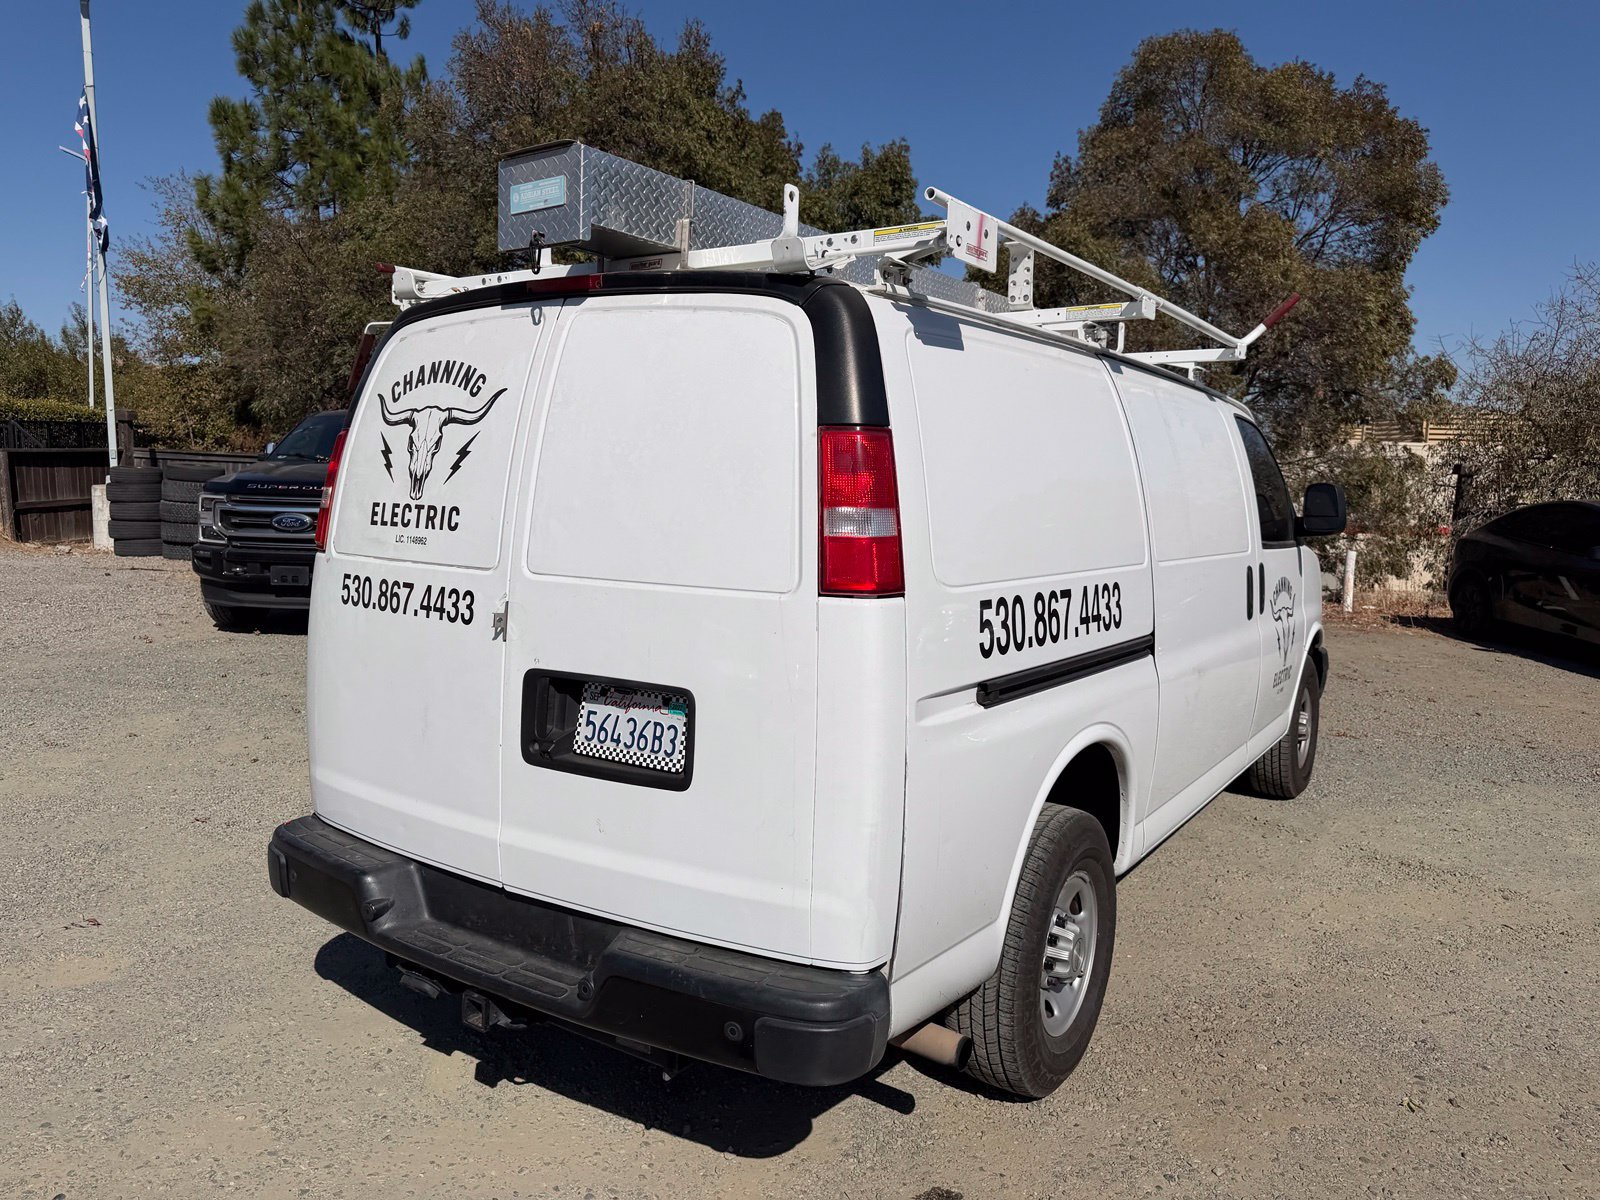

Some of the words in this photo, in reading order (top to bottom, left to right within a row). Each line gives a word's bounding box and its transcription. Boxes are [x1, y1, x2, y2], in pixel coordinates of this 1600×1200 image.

[391, 359, 487, 404] CHANNING
[280, 517, 301, 527] Ford
[370, 502, 461, 532] ELECTRIC
[341, 573, 475, 625] 530.867.4433
[979, 582, 1122, 659] 530.867.4433
[604, 691, 667, 715] California
[584, 710, 679, 758] 56436B3
